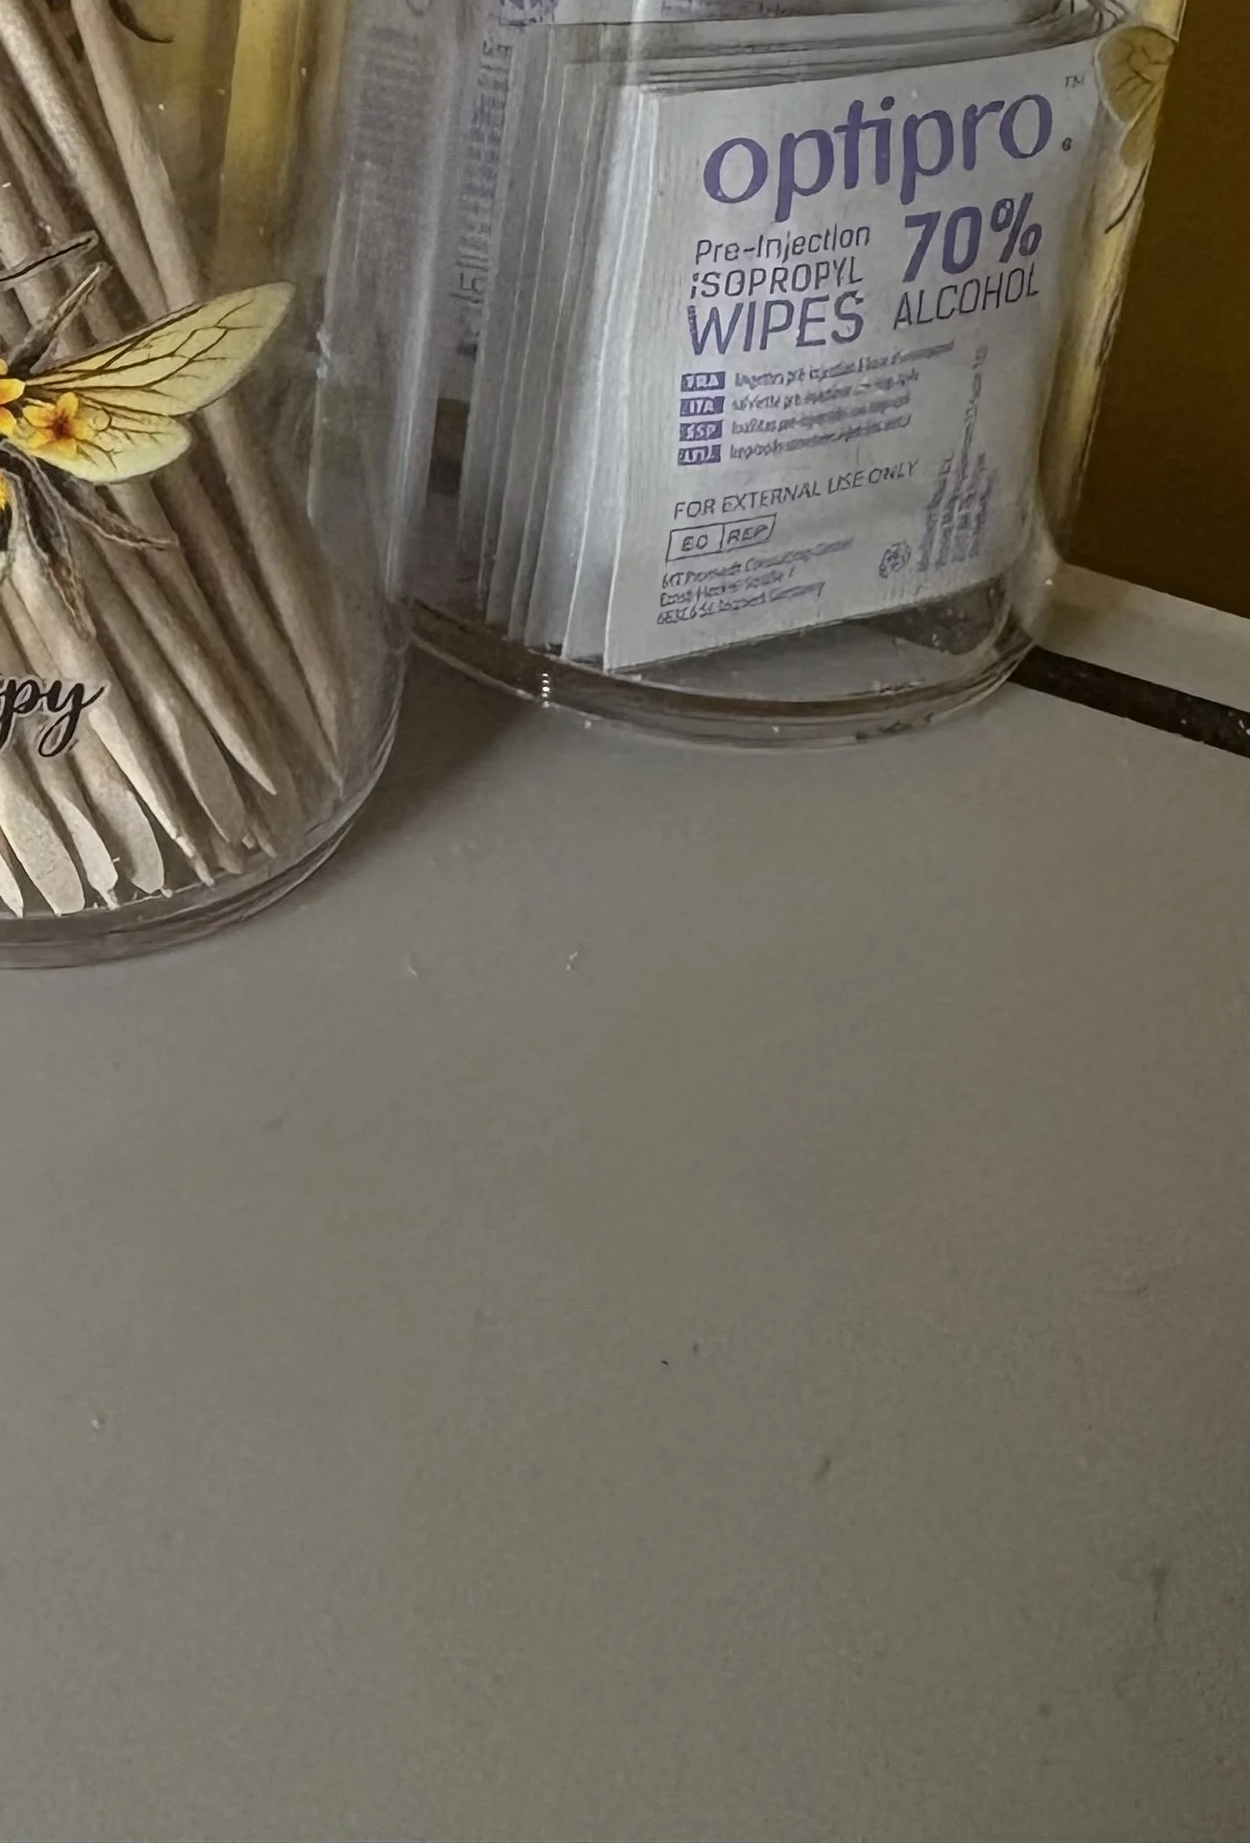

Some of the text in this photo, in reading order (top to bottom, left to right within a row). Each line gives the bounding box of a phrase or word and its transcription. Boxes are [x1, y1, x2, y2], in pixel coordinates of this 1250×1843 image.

[703, 94, 1053, 223] optipro
[695, 223, 870, 265] Pre-Injection
[902, 192, 1042, 283] 70%
[687, 291, 865, 356] WIPES
[893, 262, 1039, 331] ALCOHOL
[674, 459, 919, 520] FOR EXTERNAL USE ONLY
